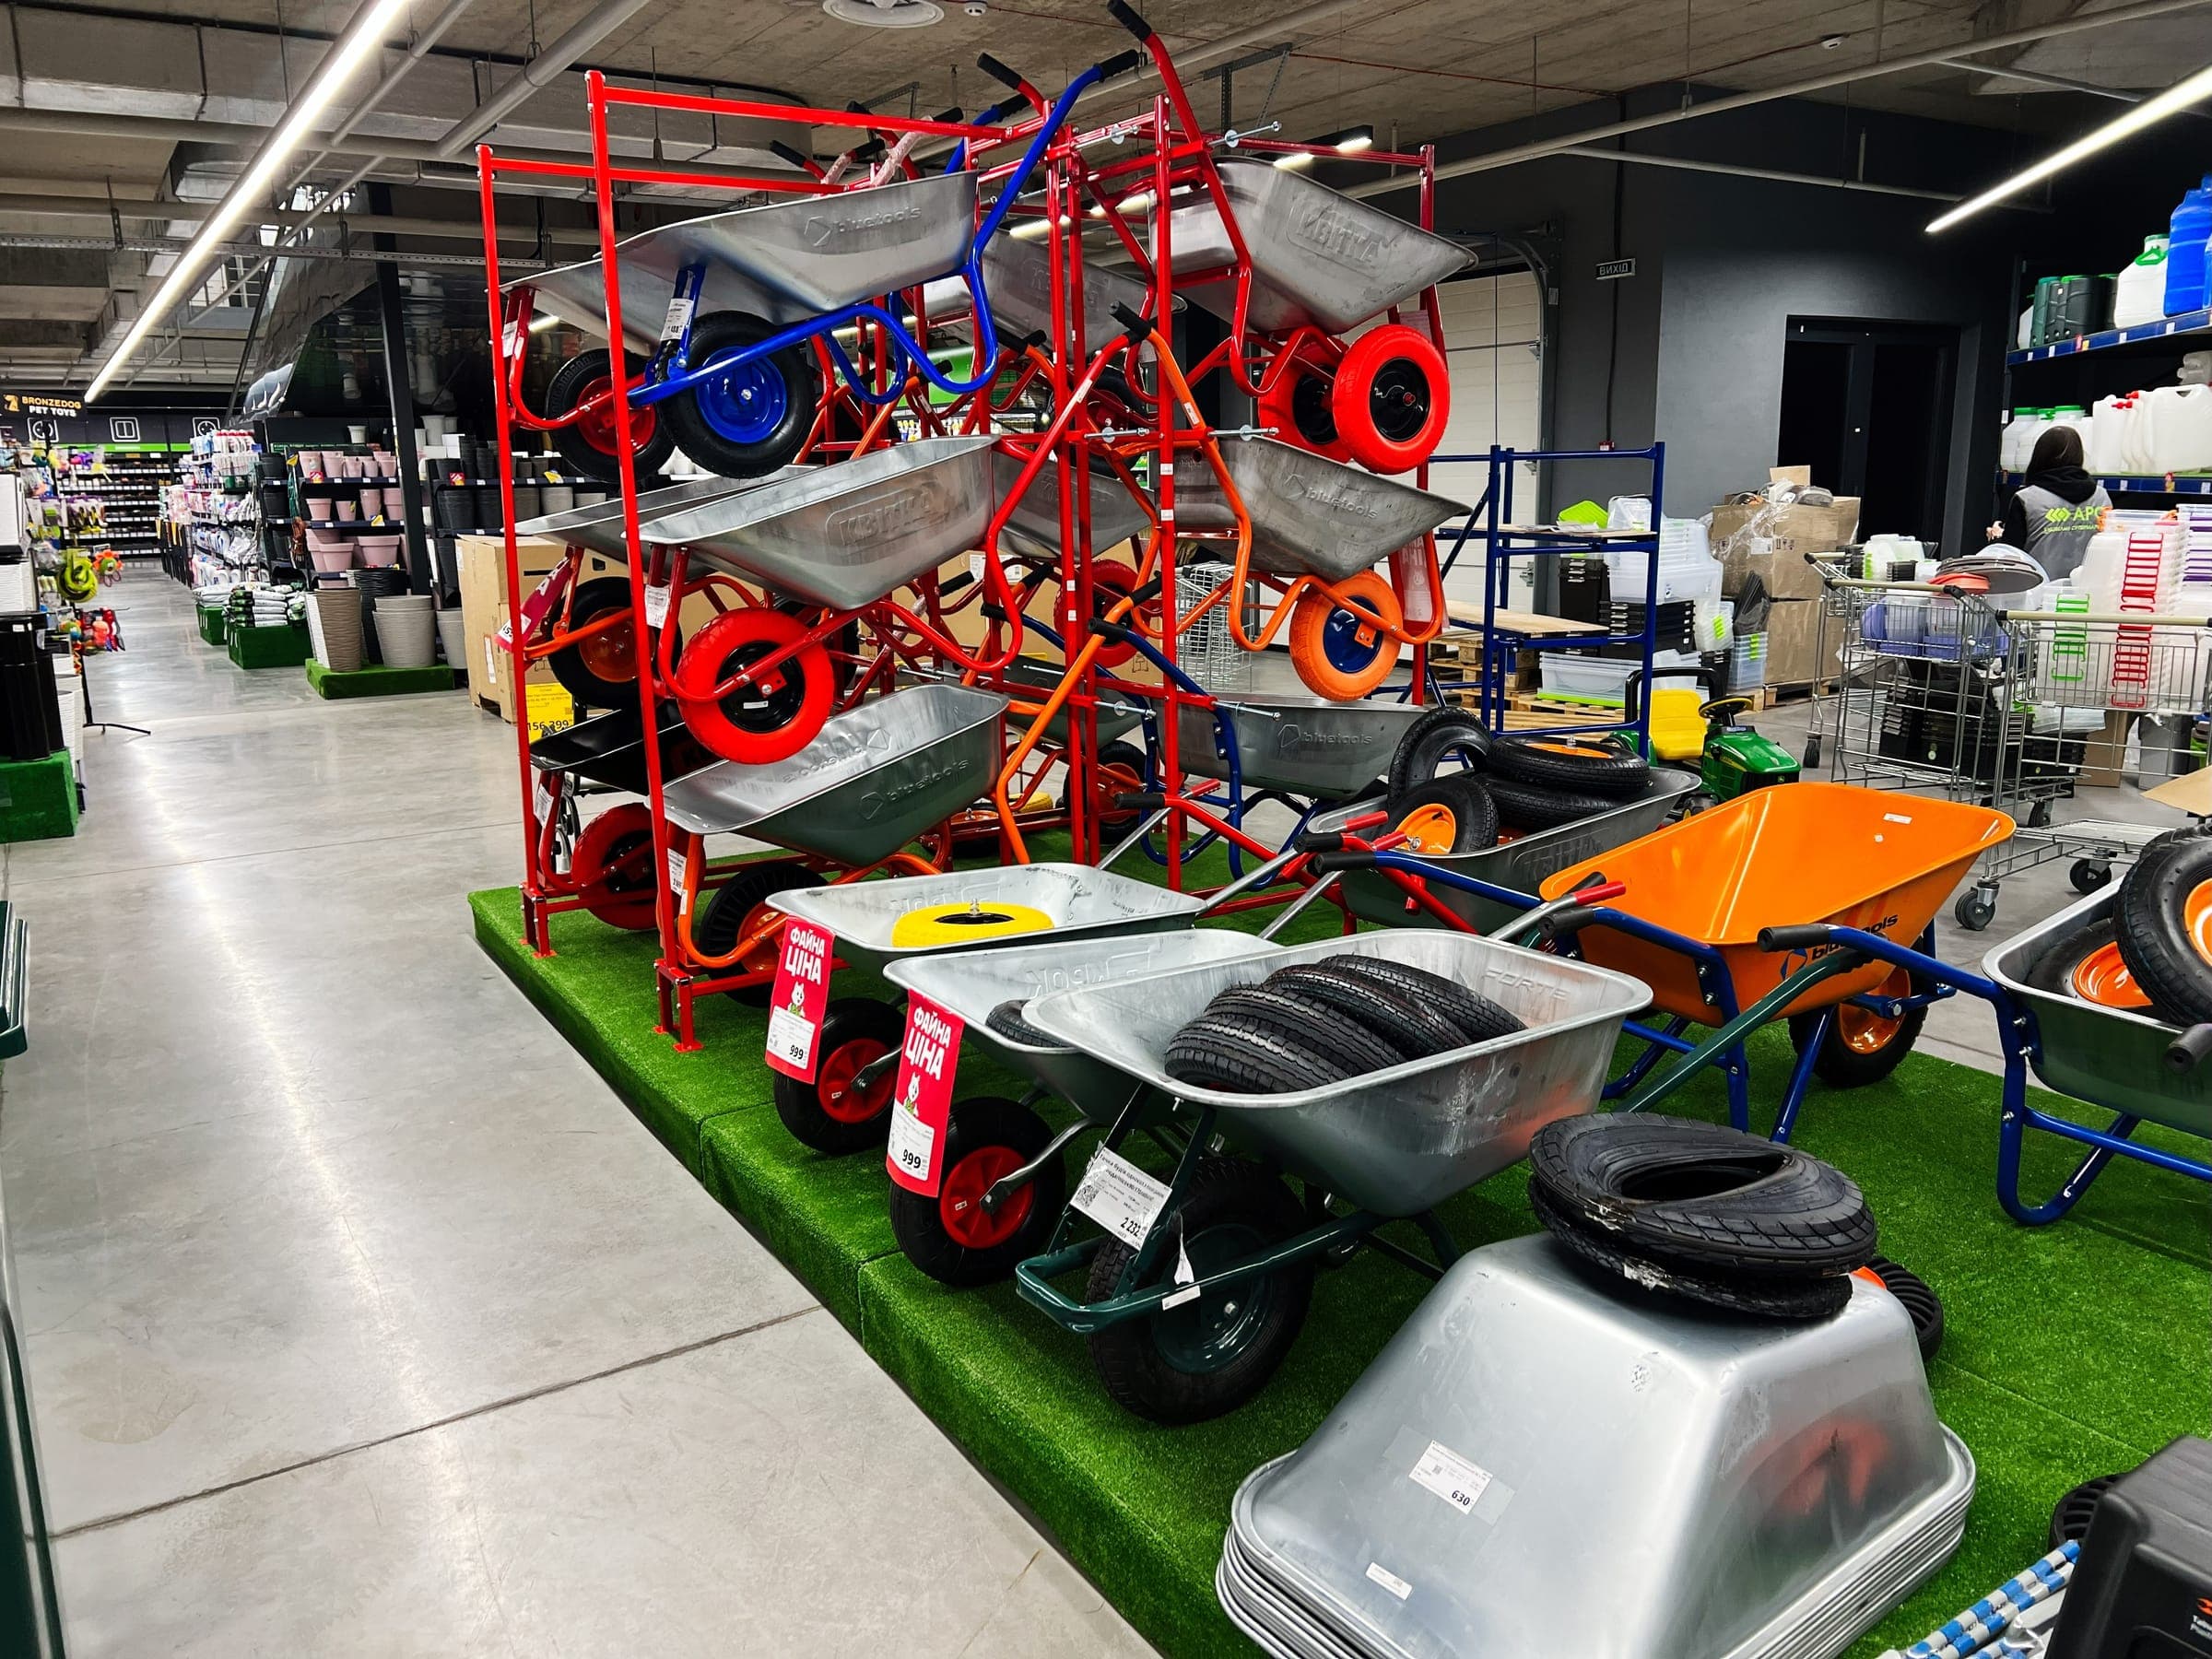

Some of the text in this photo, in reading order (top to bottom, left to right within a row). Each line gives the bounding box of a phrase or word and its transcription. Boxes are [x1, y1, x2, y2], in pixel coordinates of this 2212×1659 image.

[1599, 263, 1629, 276] ВИХІД
[21, 395, 82, 409] BRONZEDOG
[29, 406, 77, 418] PET TOYS
[1306, 487, 1379, 519] bluetools
[1301, 731, 1372, 746] bluetools
[790, 926, 826, 958] ФАЙНА
[784, 946, 822, 985] ЦІНА
[1482, 966, 1571, 1001] FORTE
[913, 1006, 952, 1049] ФАЙНА
[789, 1044, 805, 1060] 999
[905, 1027, 946, 1081] ЦІНА
[901, 1148, 922, 1170] 999
[1126, 1219, 1142, 1237] 232
[1451, 1489, 1471, 1506] 630
